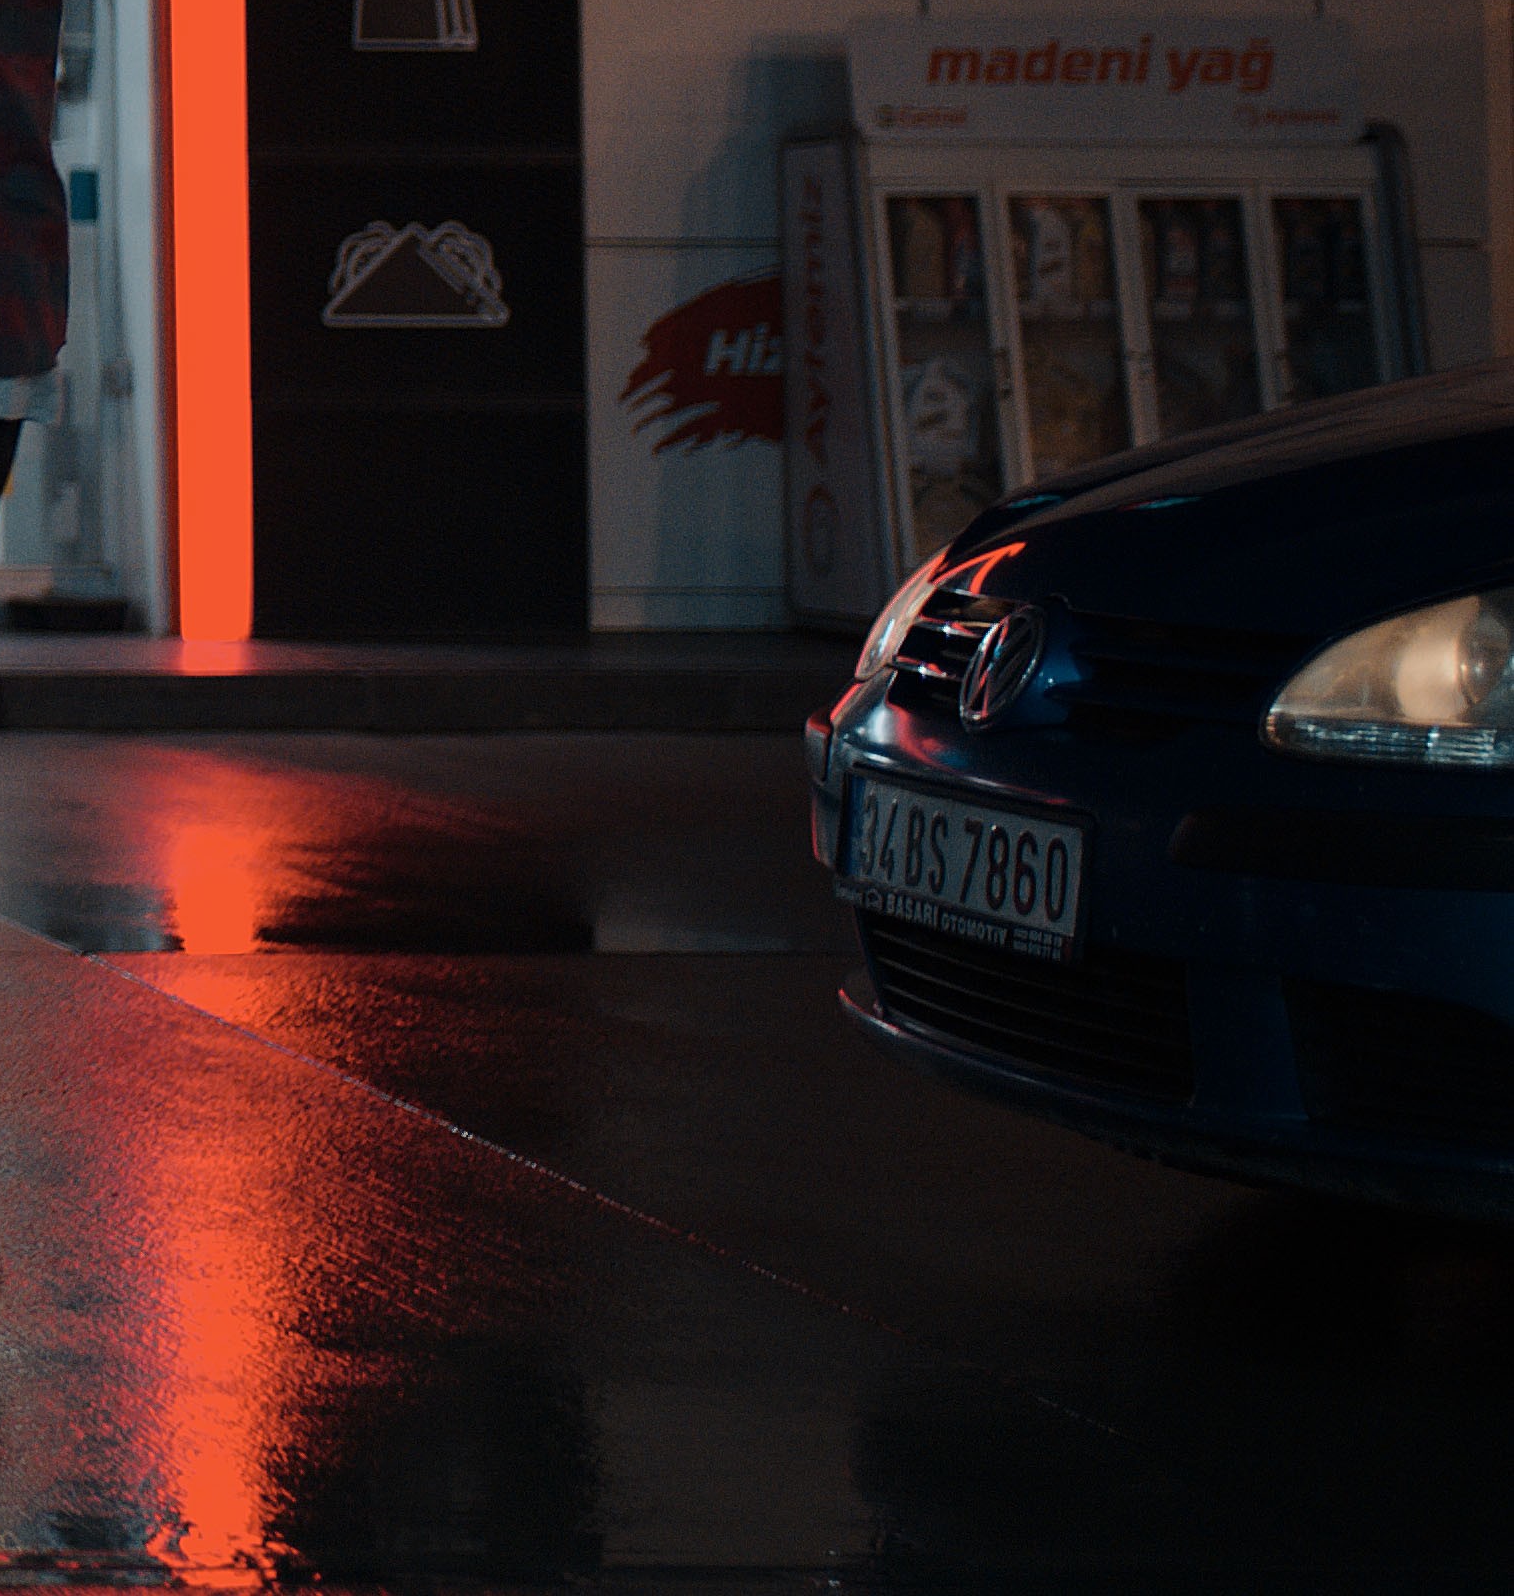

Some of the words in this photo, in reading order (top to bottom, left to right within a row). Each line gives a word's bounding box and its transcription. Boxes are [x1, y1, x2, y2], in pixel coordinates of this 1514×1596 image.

[927, 33, 1154, 84] madeni
[1166, 38, 1275, 93] yağ
[860, 786, 898, 880] 34
[905, 804, 949, 894] BS
[960, 817, 1069, 921] 7860
